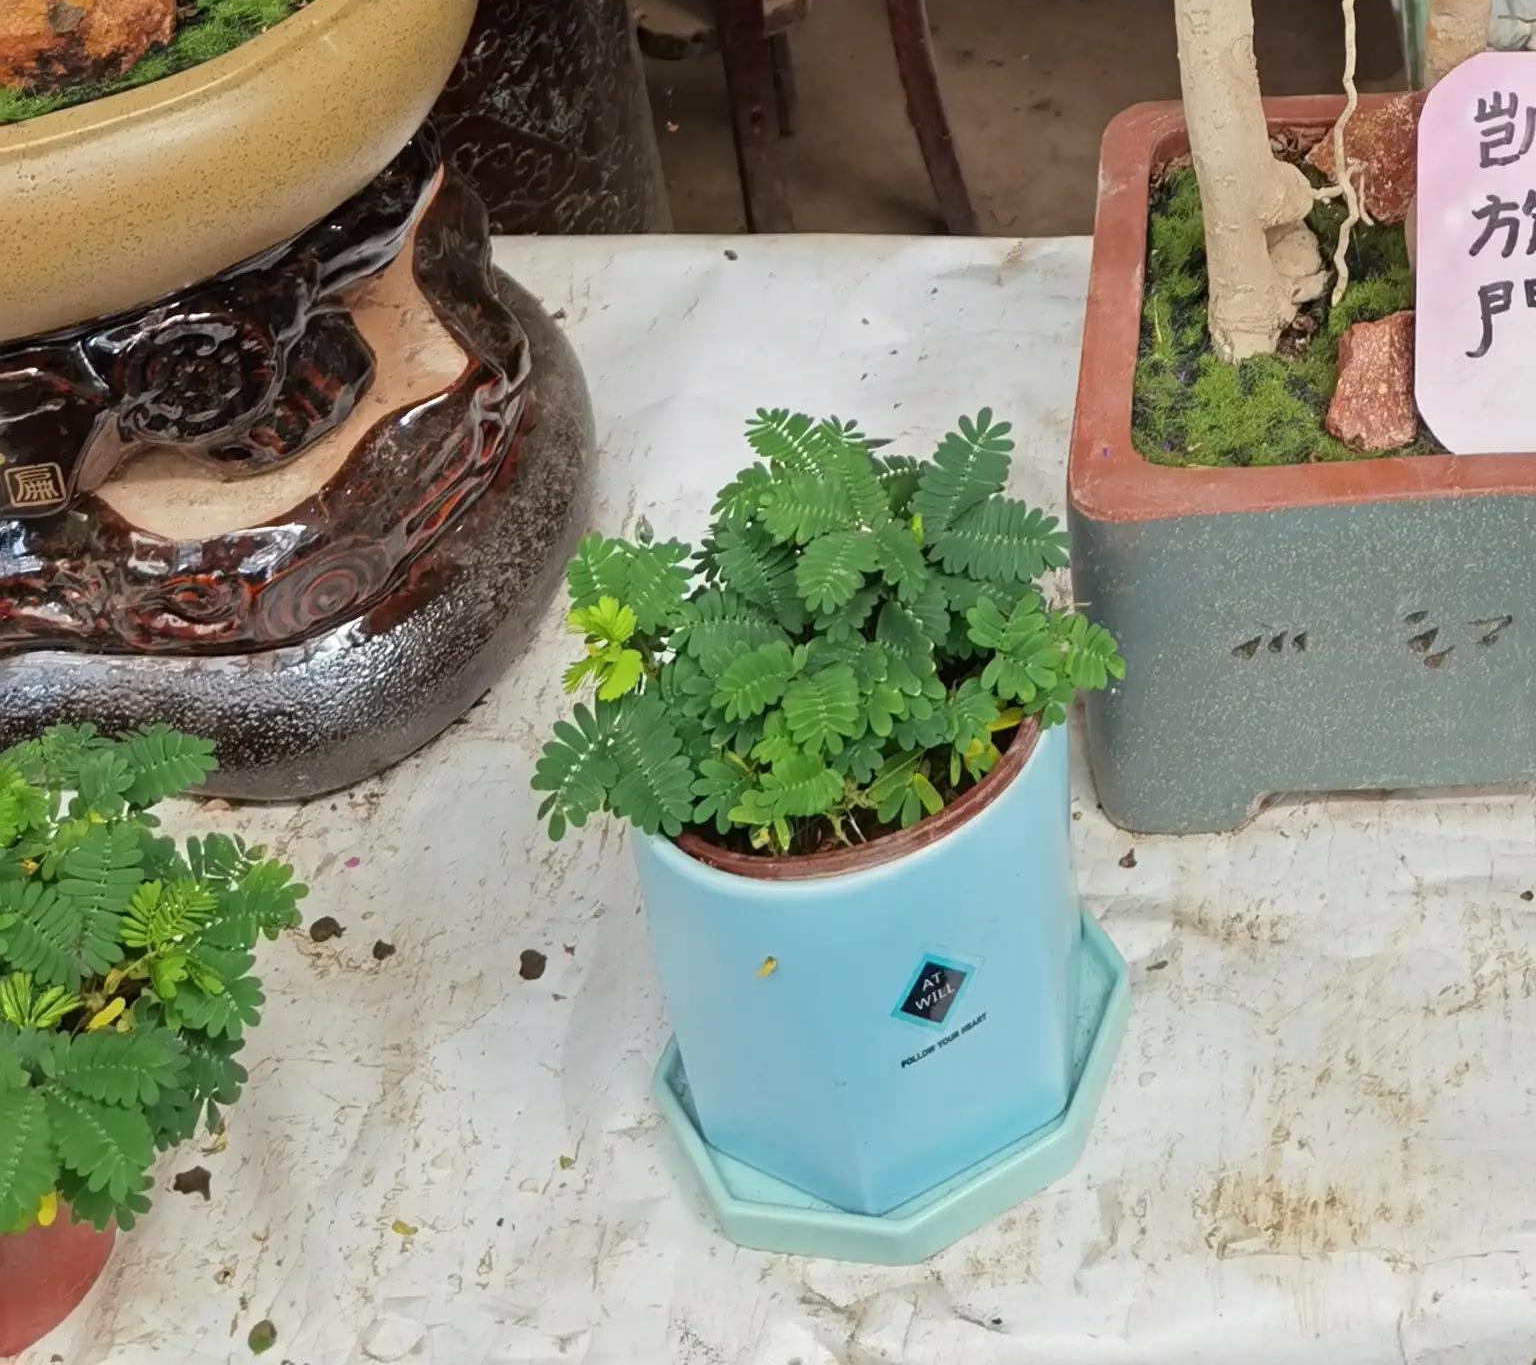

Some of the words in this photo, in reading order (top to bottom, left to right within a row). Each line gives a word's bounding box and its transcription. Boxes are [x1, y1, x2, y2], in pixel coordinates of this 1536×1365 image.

[922, 972, 942, 992] AT
[915, 983, 955, 1010] WILL
[901, 1045, 936, 1069] FOLLOW
[937, 1030, 960, 1048] YOUR
[961, 1011, 987, 1034] HEART
